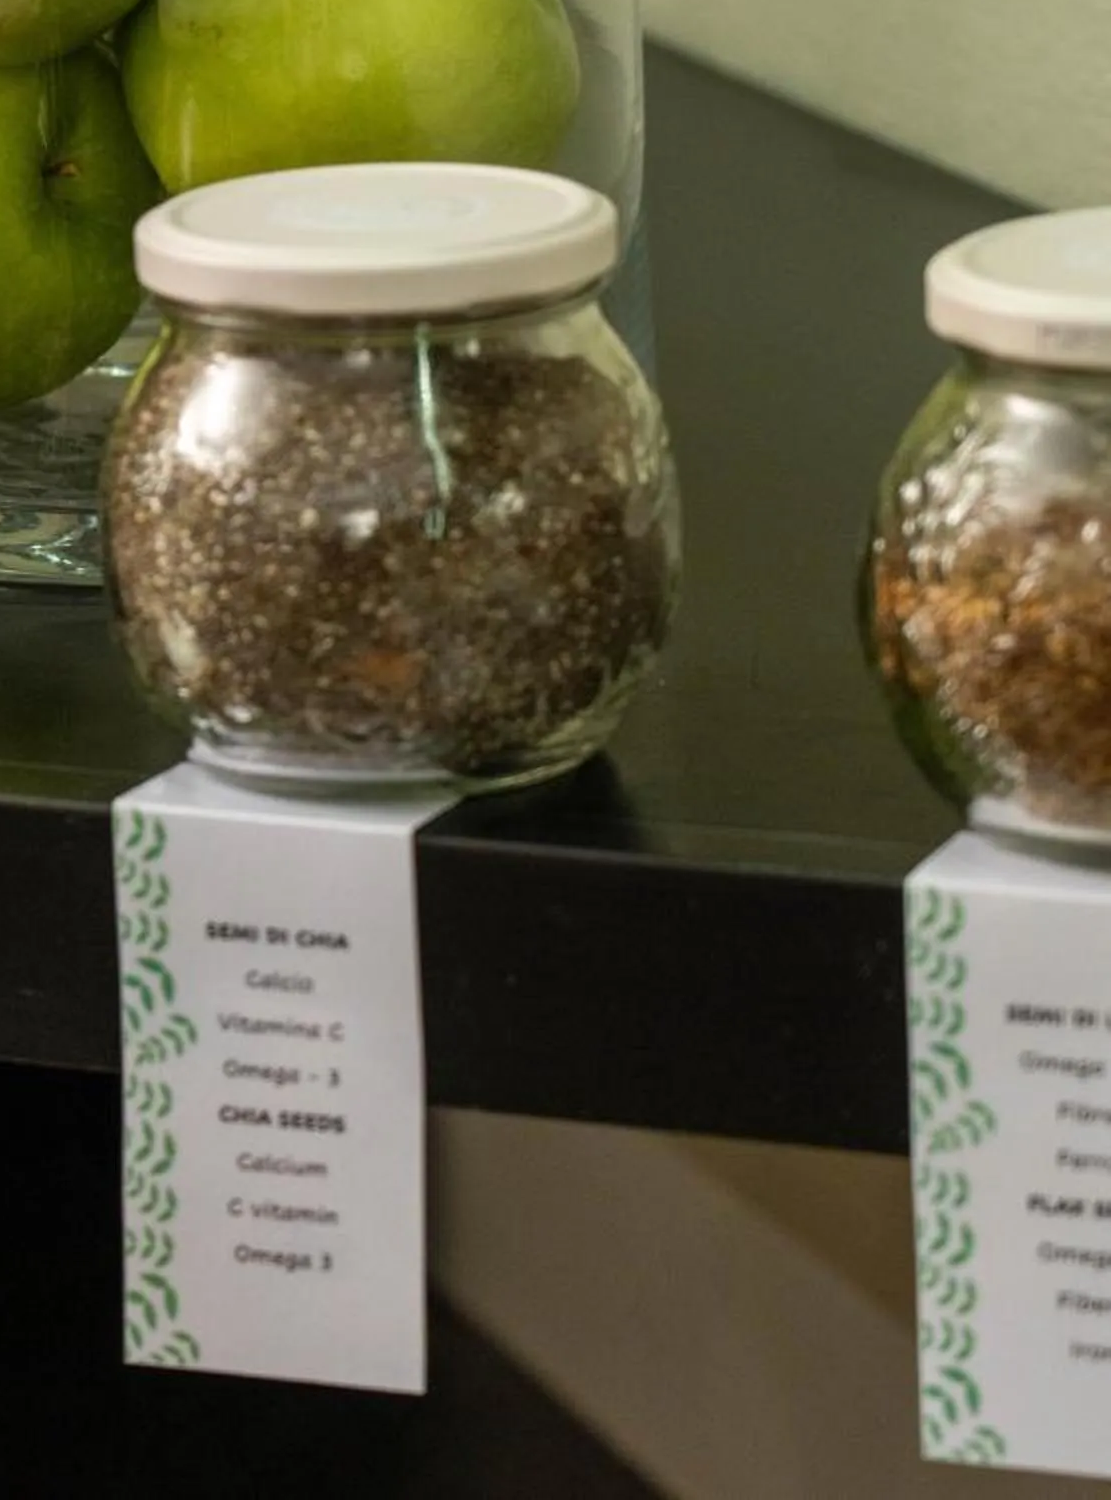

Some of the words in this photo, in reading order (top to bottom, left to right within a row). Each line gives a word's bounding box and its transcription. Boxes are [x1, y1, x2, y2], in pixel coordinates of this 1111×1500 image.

[204, 920, 260, 943] SEMI
[265, 926, 289, 946] DI
[294, 929, 350, 950] CHIA
[327, 1020, 345, 1043] C
[221, 1057, 301, 1088] Omega
[327, 1067, 342, 1088] 3
[216, 1103, 273, 1127] CHIA
[277, 1108, 347, 1134] SEEDS
[235, 1151, 328, 1177] Calcium
[226, 1196, 243, 1217] C
[250, 1201, 339, 1224] vitamin
[233, 1243, 313, 1273] Omega
[319, 1250, 333, 1271] 3
